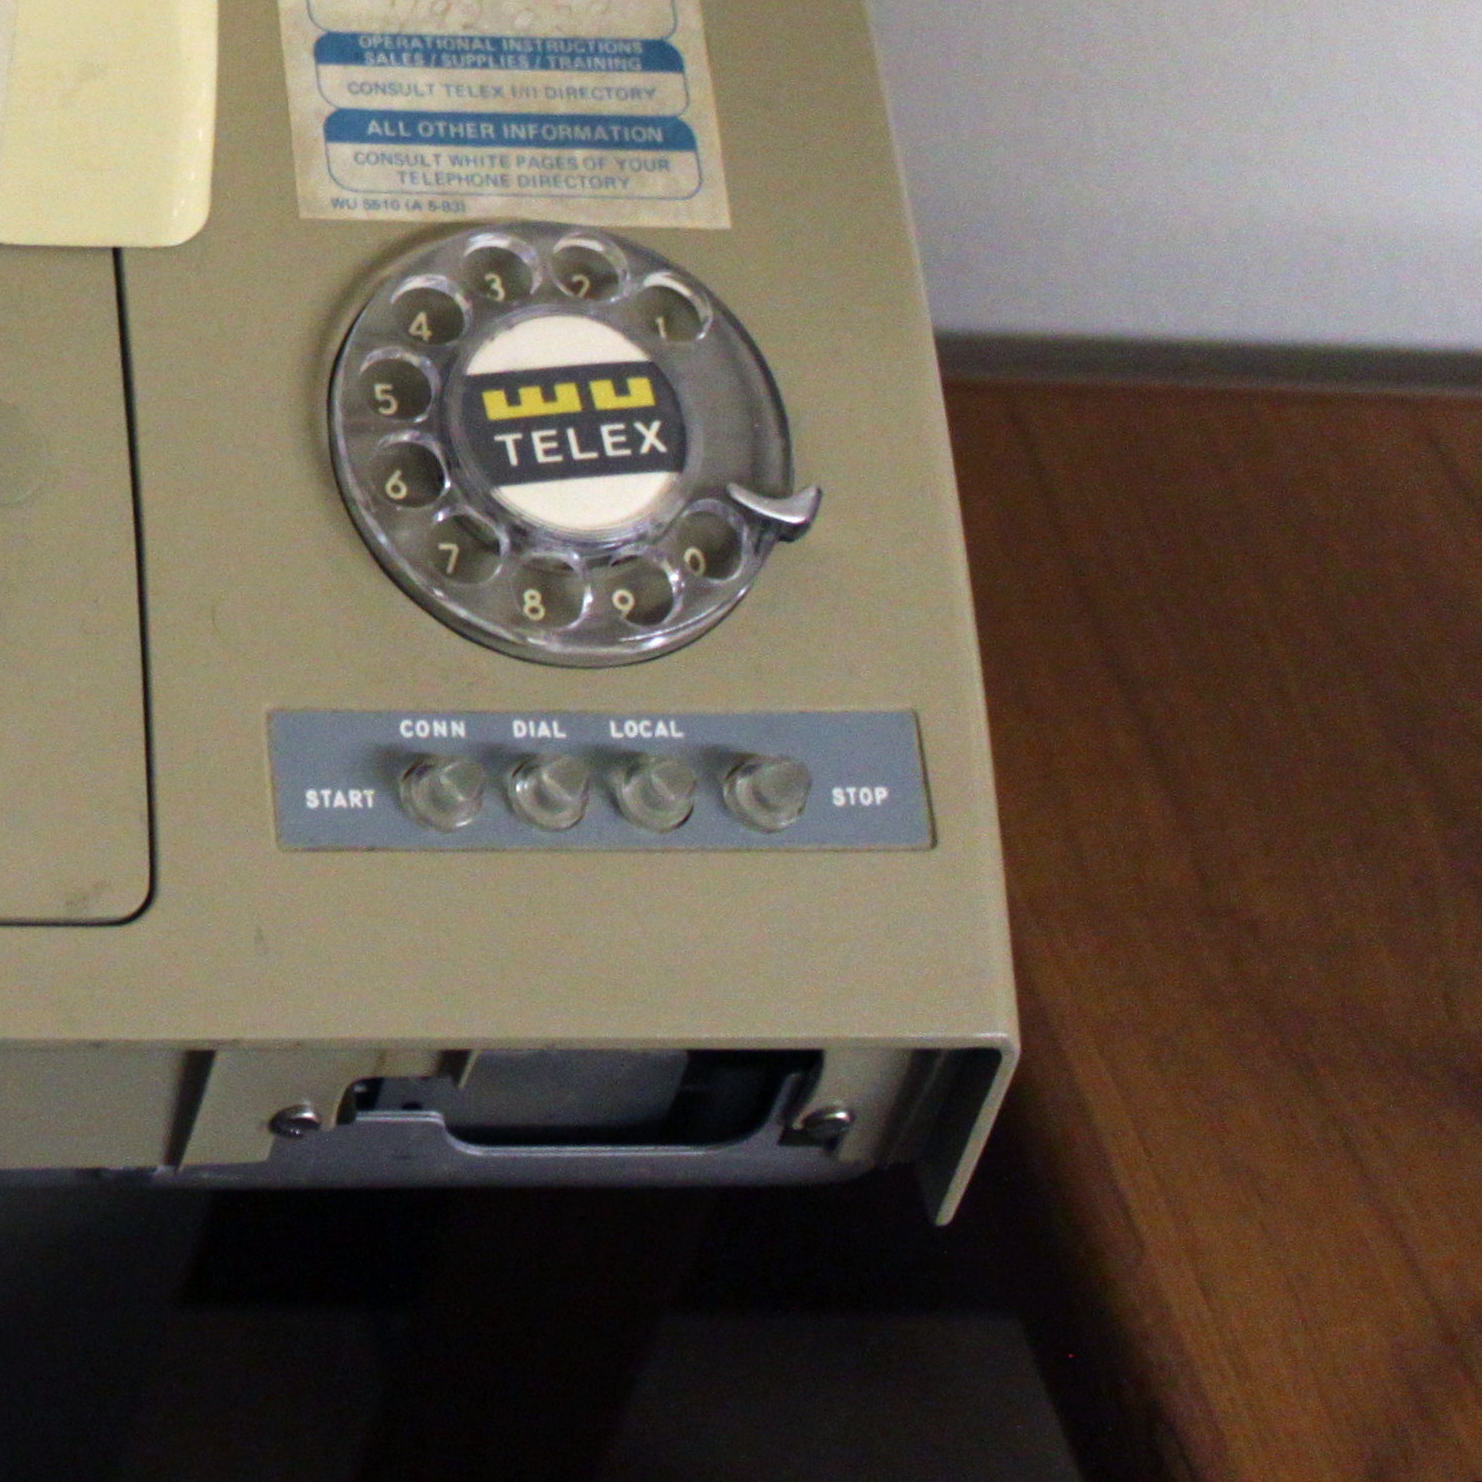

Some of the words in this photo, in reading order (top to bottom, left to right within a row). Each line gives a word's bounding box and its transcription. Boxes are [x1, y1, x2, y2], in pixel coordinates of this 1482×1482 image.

[358, 35, 496, 51] OPERATIONAL
[503, 37, 642, 54] INSTRUCTIONS
[364, 52, 424, 66] SALES
[441, 54, 528, 68] SUPPLIES
[548, 56, 642, 71] TRAINING
[348, 82, 434, 95] CONSULT
[445, 83, 503, 97] TELEX
[546, 86, 656, 100] DIRECTORY
[367, 120, 411, 136] ALL
[418, 121, 495, 138] OTHER
[504, 124, 663, 141] INFORMATION
[354, 153, 442, 167] CONSULT
[449, 155, 509, 168] WHITE
[517, 156, 578, 170] PAGES
[584, 157, 606, 170] OF
[618, 157, 669, 172] YOUR
[398, 171, 510, 187] TELEPHONE
[518, 174, 630, 189] DIRECTORY
[485, 274, 504, 302] 3
[572, 275, 590, 298] 2
[409, 313, 430, 341] 4
[656, 317, 666, 338] 1
[374, 384, 398, 415] 5
[494, 421, 667, 466] TELEX
[385, 470, 406, 499] 6
[439, 544, 458, 574] 7
[523, 590, 545, 620] 8
[612, 589, 634, 618] 9
[399, 721, 466, 738] CONN
[512, 721, 566, 738] DIAL
[610, 721, 684, 738] LOCAL
[305, 790, 375, 808] START
[832, 788, 889, 806] STOP
